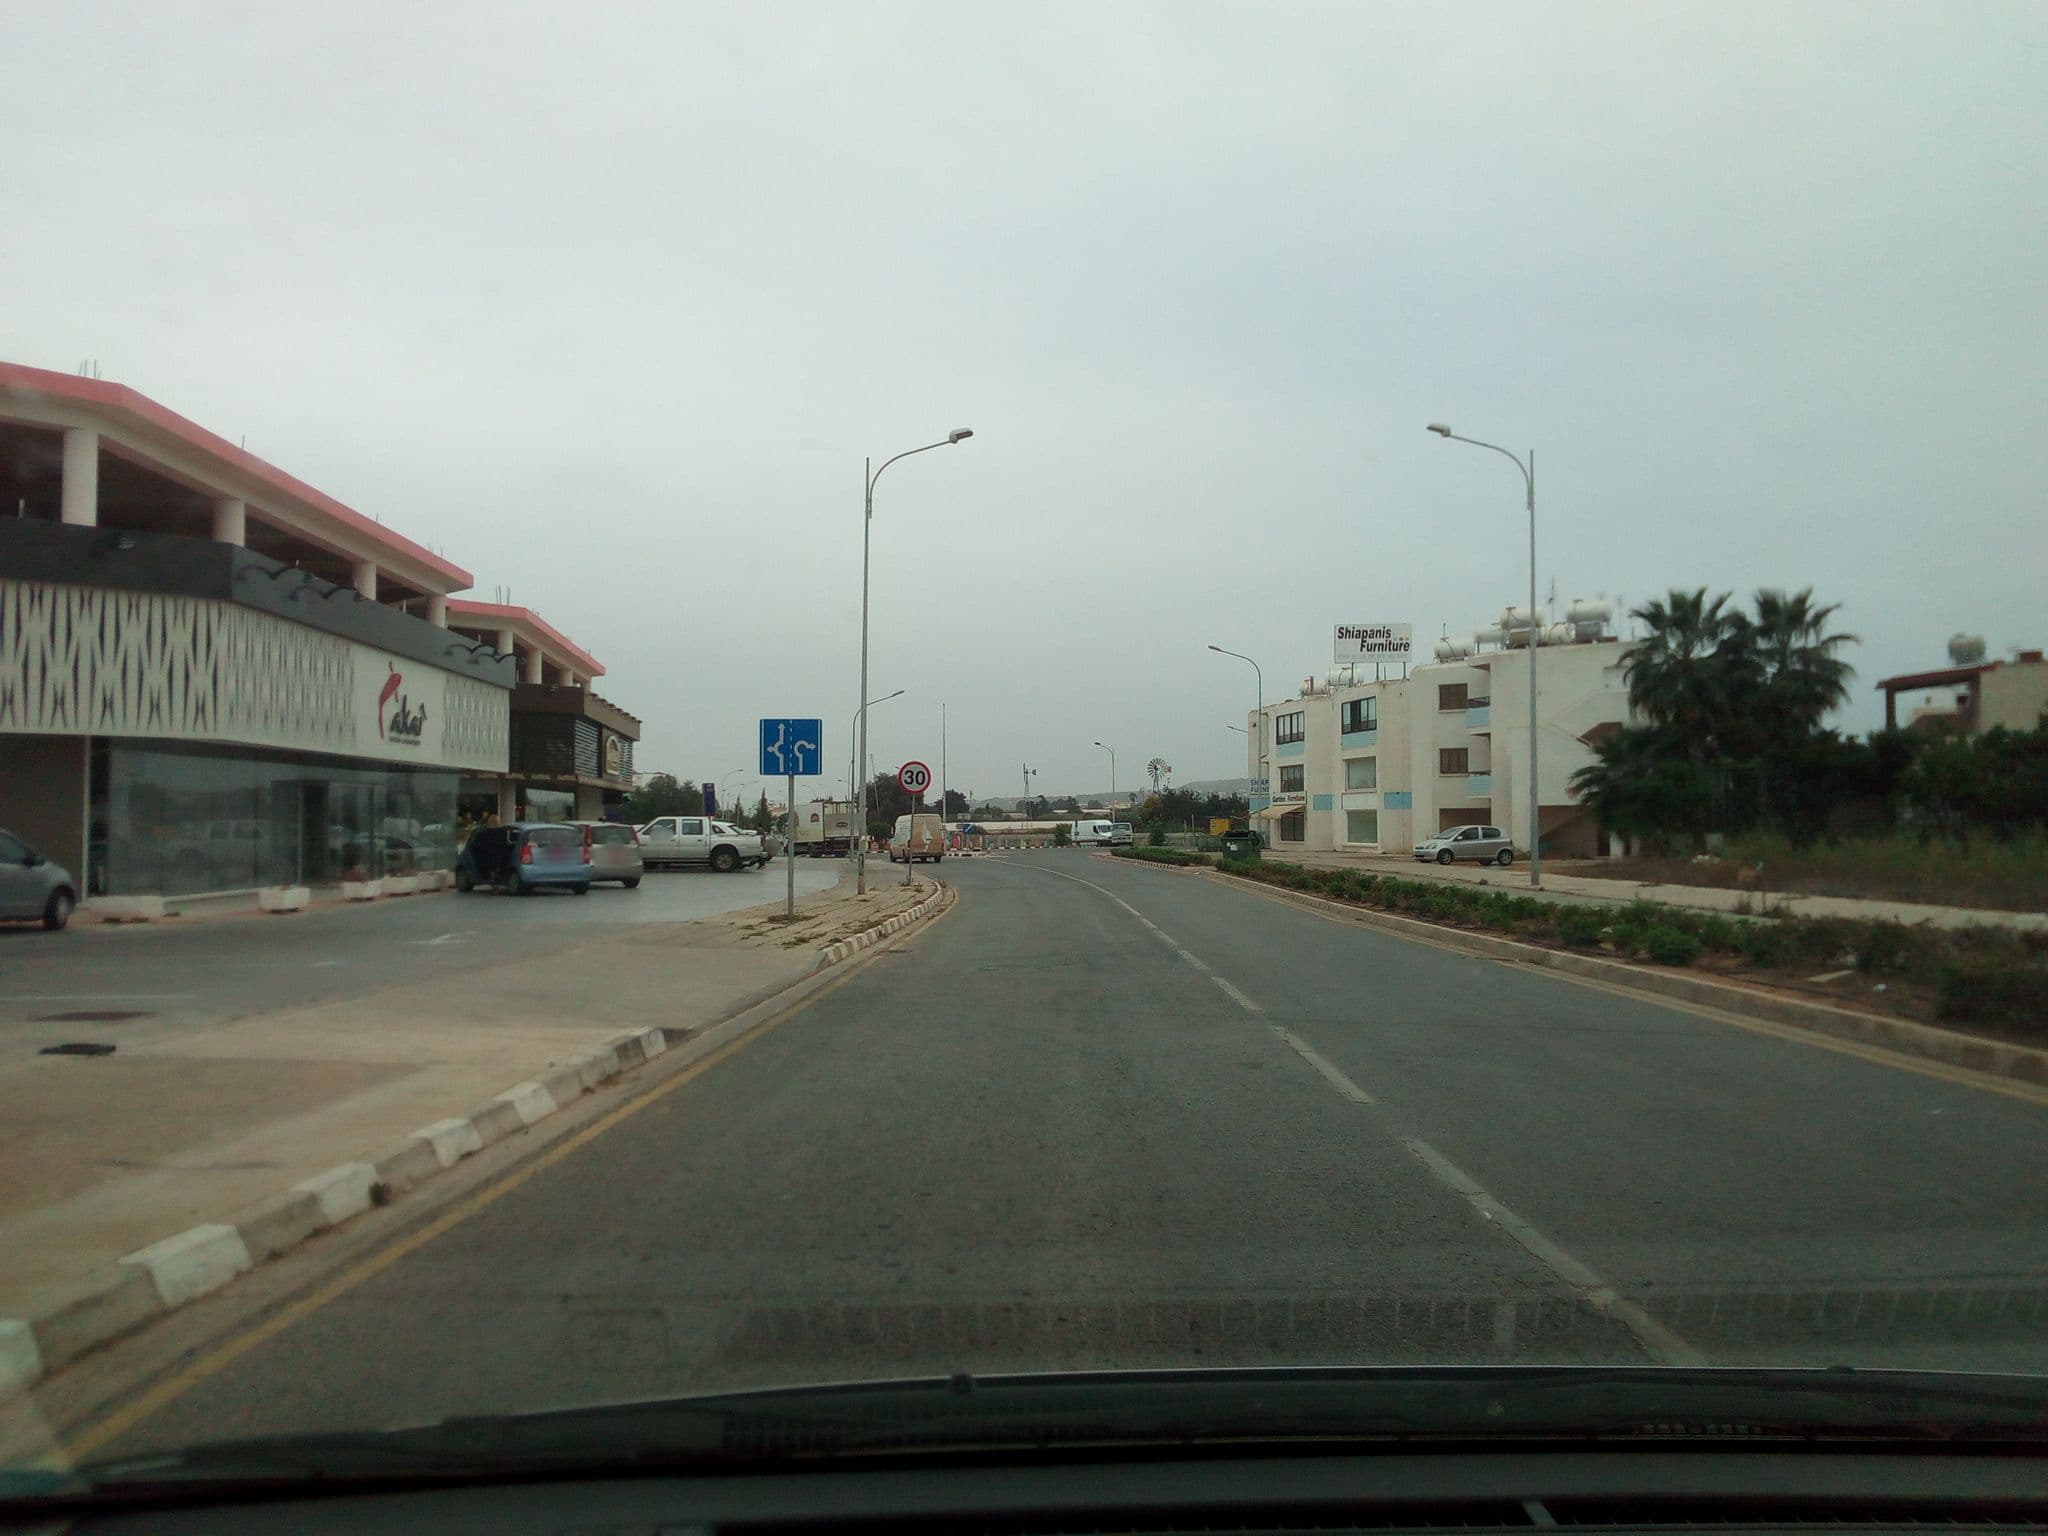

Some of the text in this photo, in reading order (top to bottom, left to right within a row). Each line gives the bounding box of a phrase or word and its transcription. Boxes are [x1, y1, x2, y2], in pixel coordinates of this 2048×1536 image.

[1337, 626, 1392, 640] Shiapanis
[1360, 639, 1410, 652] Furniture
[904, 770, 926, 785] 30
